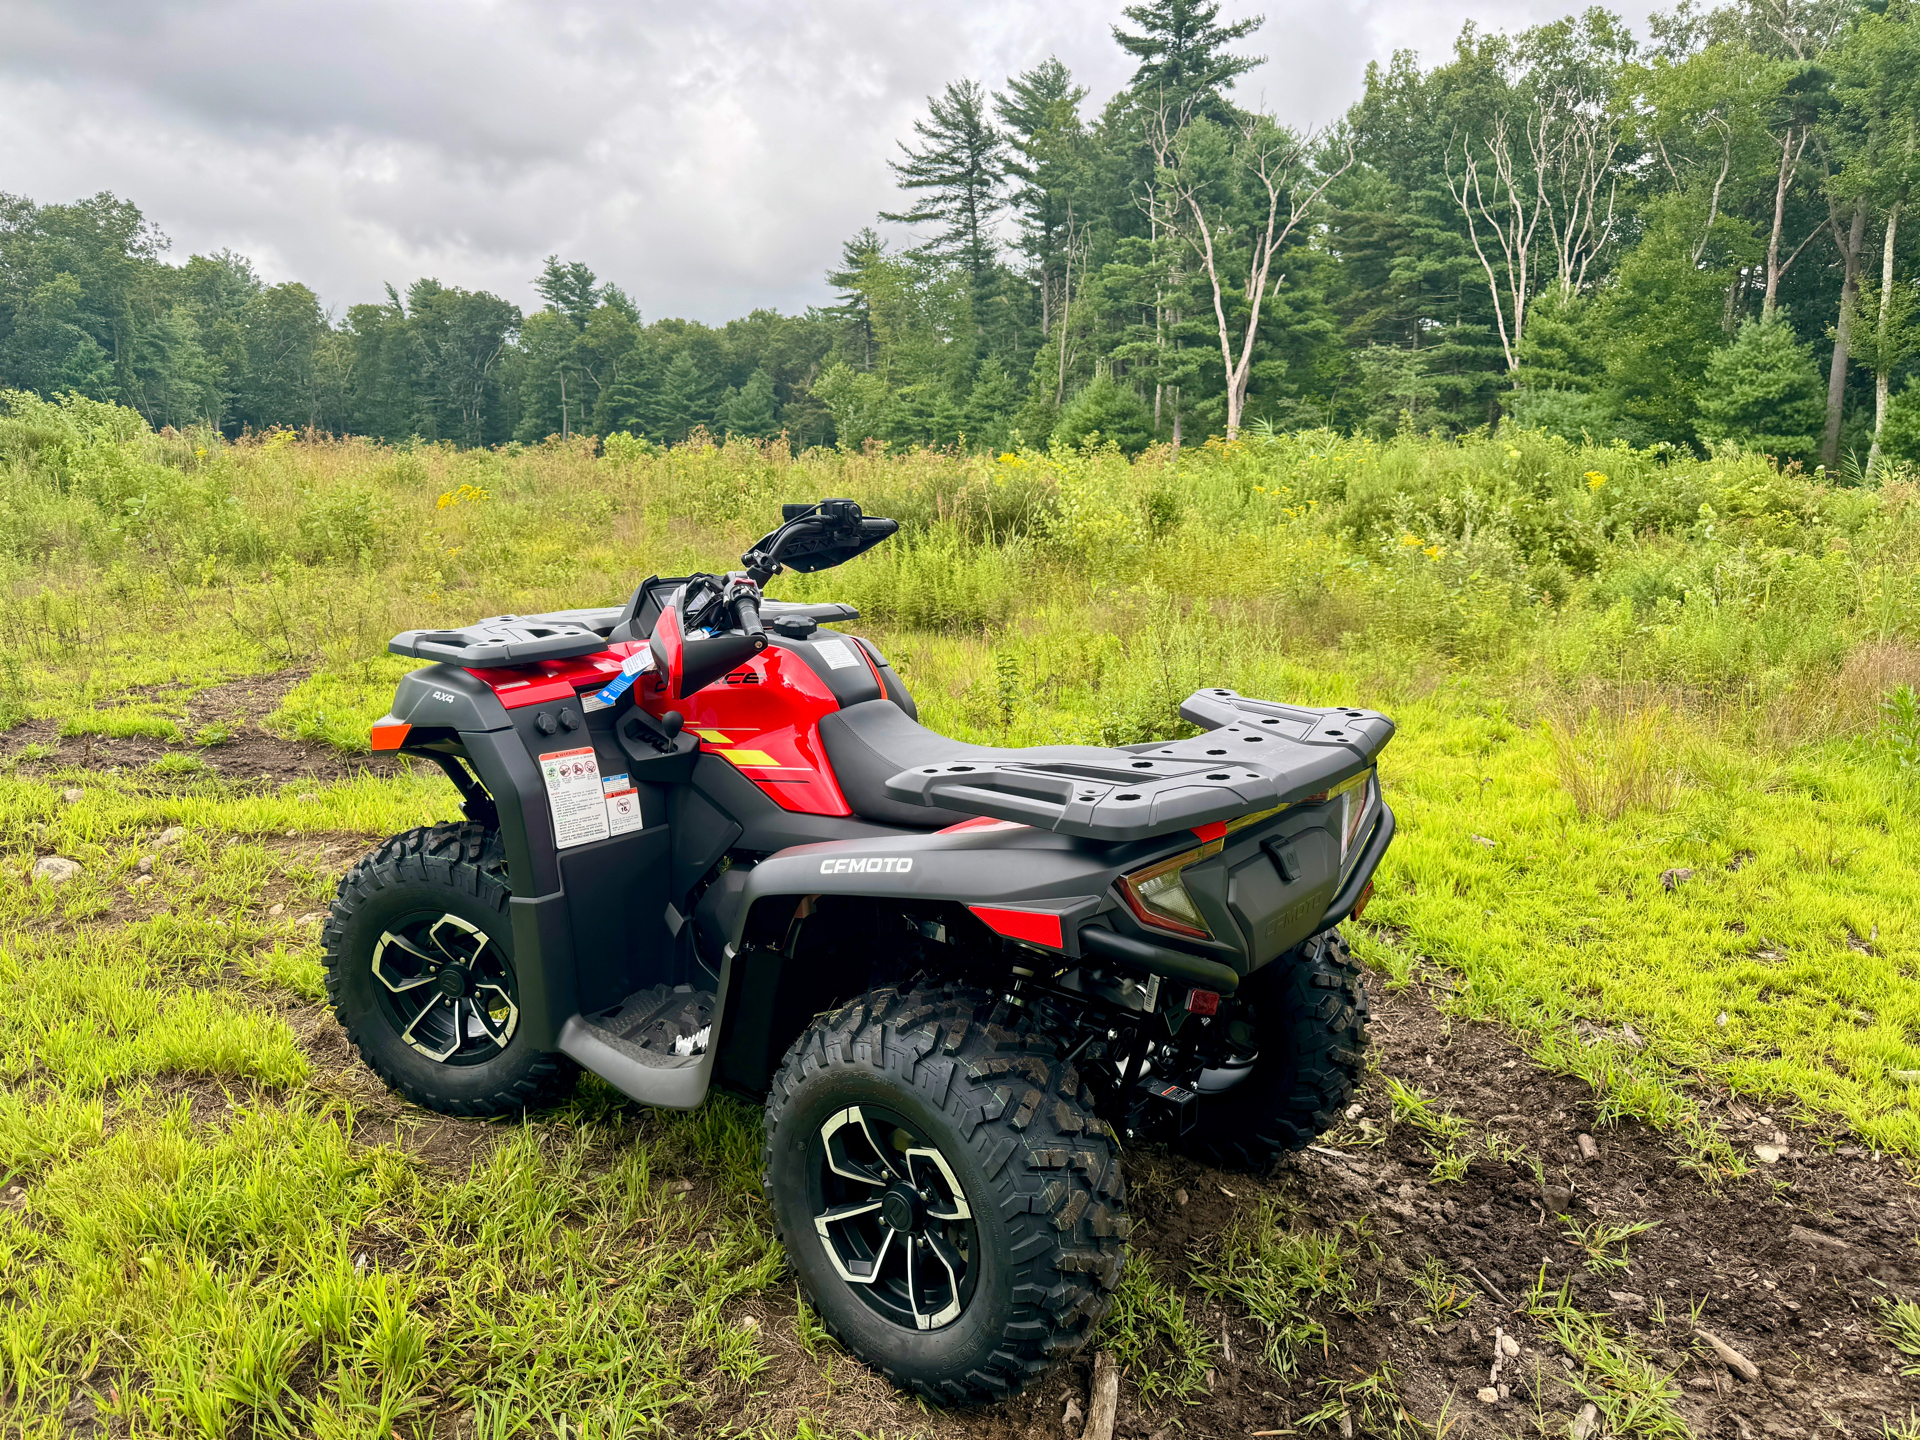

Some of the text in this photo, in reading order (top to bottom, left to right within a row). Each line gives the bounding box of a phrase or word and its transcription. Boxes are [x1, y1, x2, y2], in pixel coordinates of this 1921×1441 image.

[820, 857, 914, 875] CFMOTO
[1265, 891, 1323, 939] CFMOTO
[940, 1321, 993, 1371] CFMOTO
